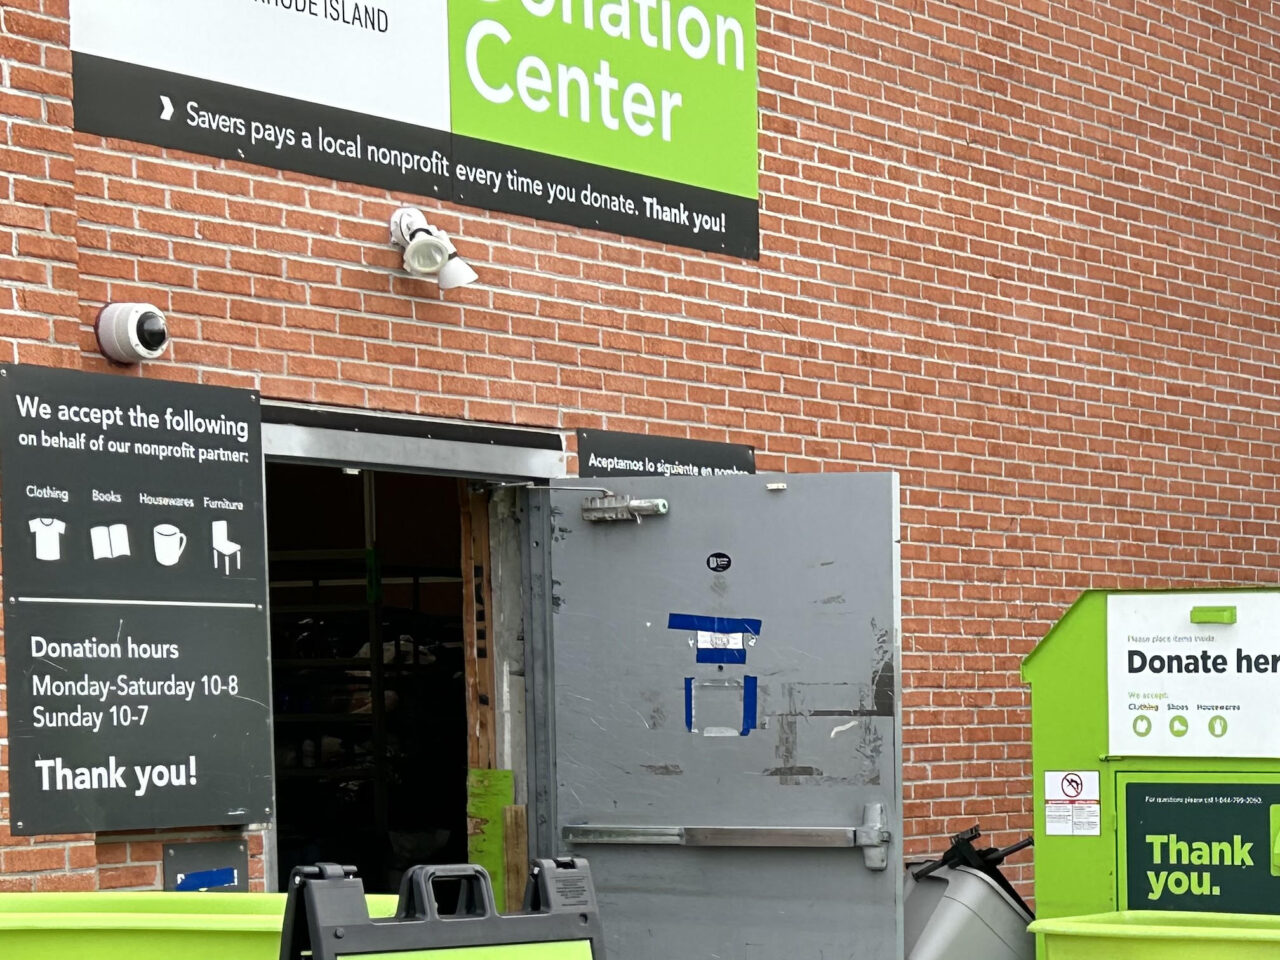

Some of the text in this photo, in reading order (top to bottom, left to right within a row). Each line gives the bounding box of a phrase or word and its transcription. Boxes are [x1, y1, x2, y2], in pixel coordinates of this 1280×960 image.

[324, 0, 389, 33] ISLAND
[465, 19, 682, 142] Center
[186, 101, 726, 233] Savers pays a local nonprofit every time you donate. Thank you!
[16, 394, 249, 442] We accept the following
[19, 430, 249, 463] on behalf of our nonprofit partner:
[589, 453, 644, 471] Aceptamos
[646, 457, 655, 471] lo
[657, 460, 698, 477] siguiente
[701, 467, 713, 476] en
[26, 485, 243, 510] Clothing Books Housewares Furniture
[31, 636, 179, 659] Donation hours
[1128, 649, 1227, 674] Donate
[32, 674, 239, 701] Monday-Saturday 10-8
[33, 705, 149, 732] Sunday 10-7
[35, 756, 197, 796] Thank you!
[1146, 834, 1254, 866] Thank
[1147, 871, 1220, 900] you.
